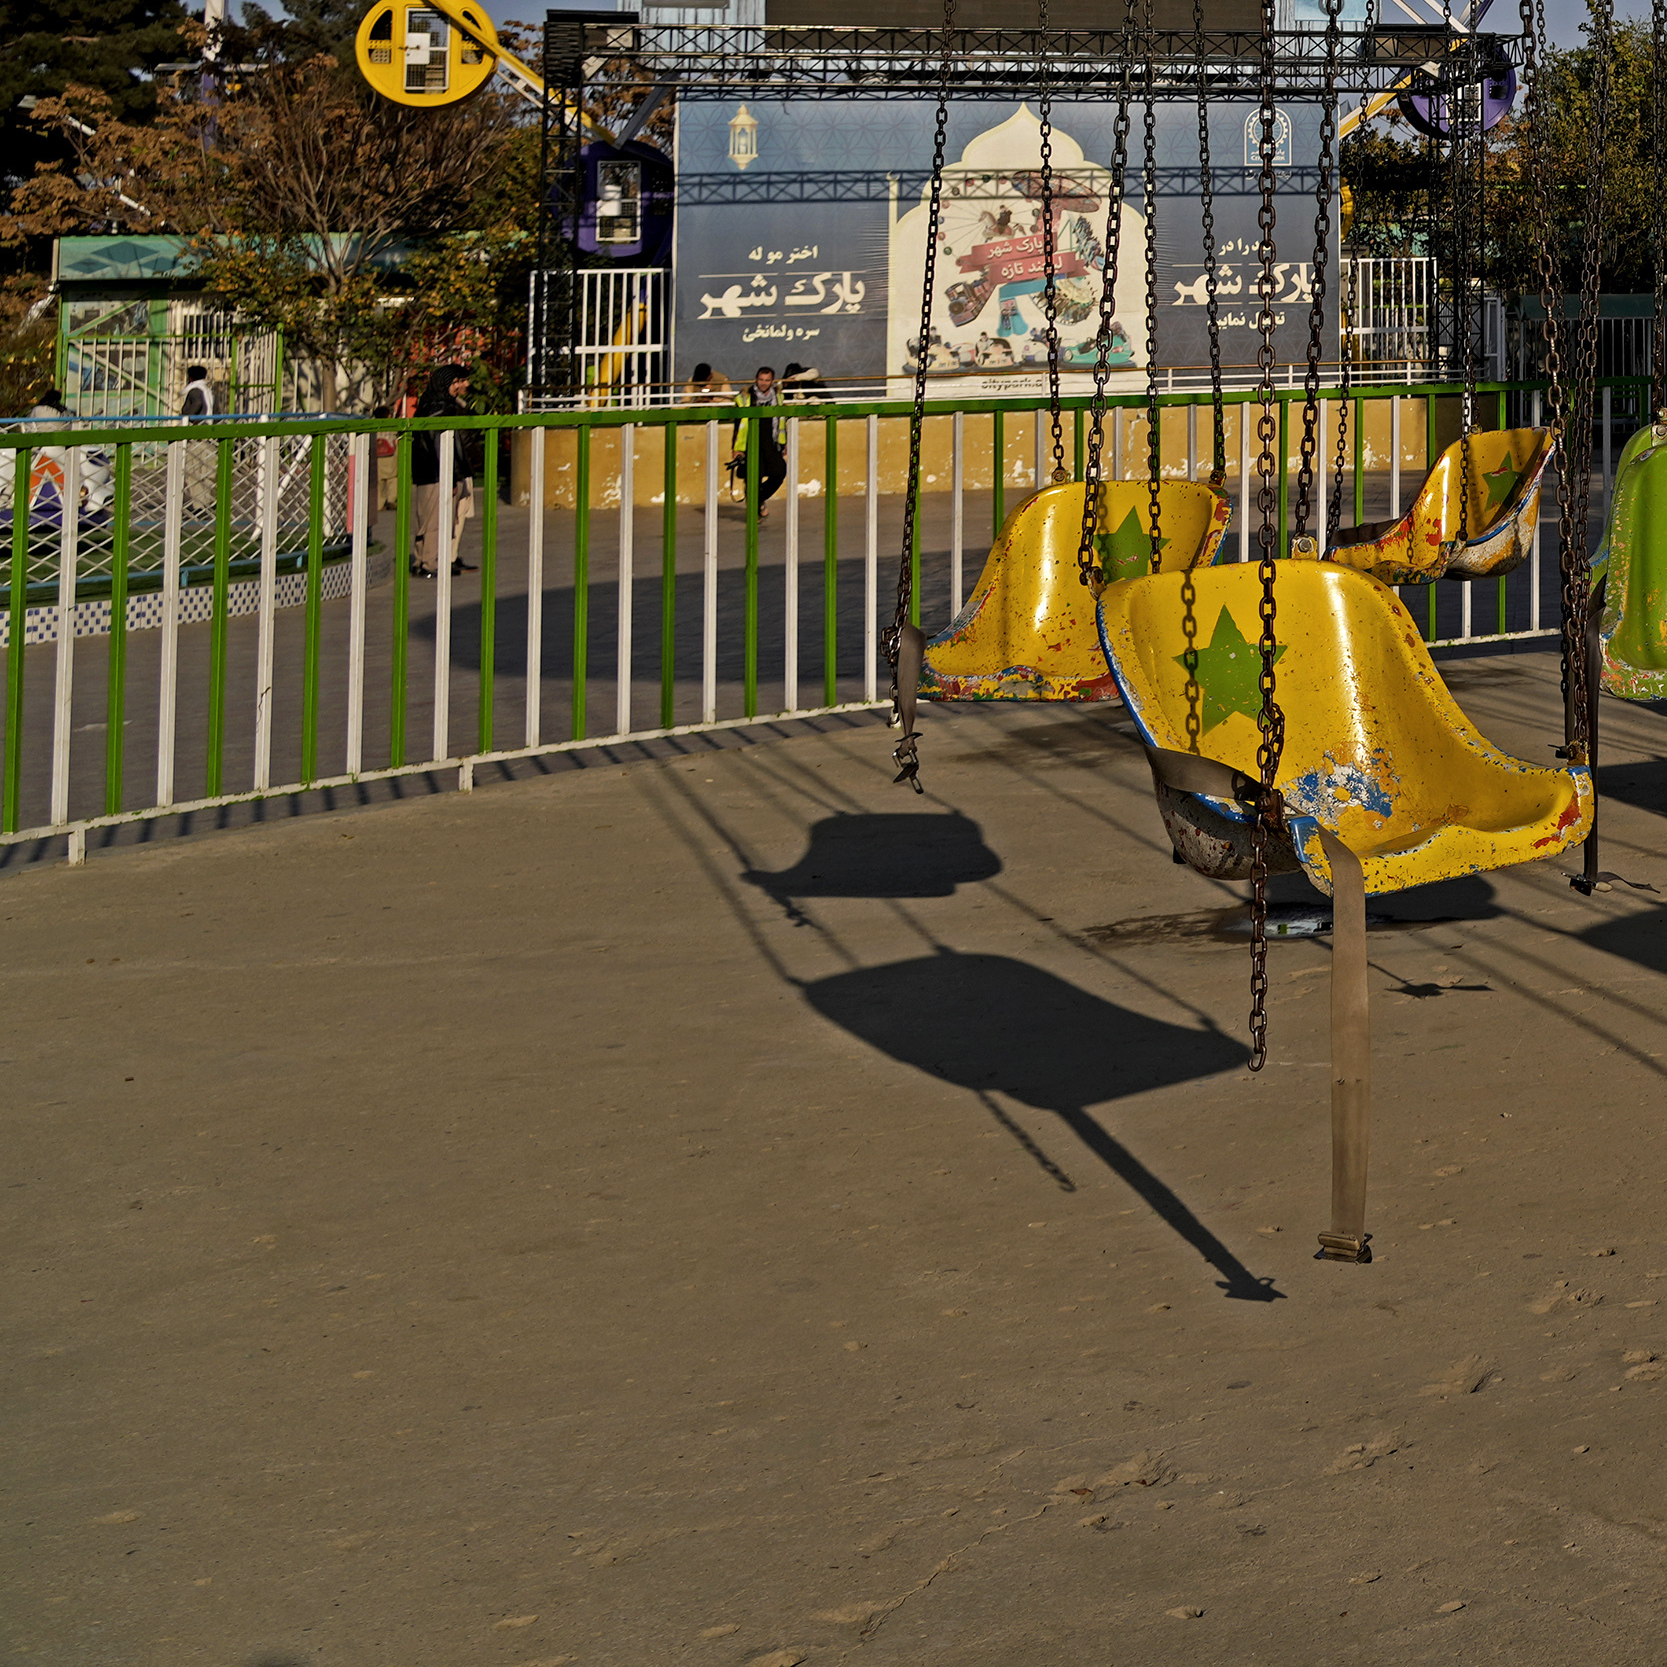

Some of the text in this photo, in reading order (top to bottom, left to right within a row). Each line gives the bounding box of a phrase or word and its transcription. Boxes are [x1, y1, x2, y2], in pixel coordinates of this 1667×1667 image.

[748, 245, 819, 265] اختر مو له
[987, 237, 1046, 259] پارک شهر
[1218, 240, 1235, 256] در
[1237, 238, 1250, 255] را
[1001, 256, 1064, 280] لبند تازه
[1171, 264, 1243, 306] شهر
[697, 272, 866, 320] پارک شهر
[795, 327, 821, 341] سره
[981, 377, 1048, 391] citypark.a
